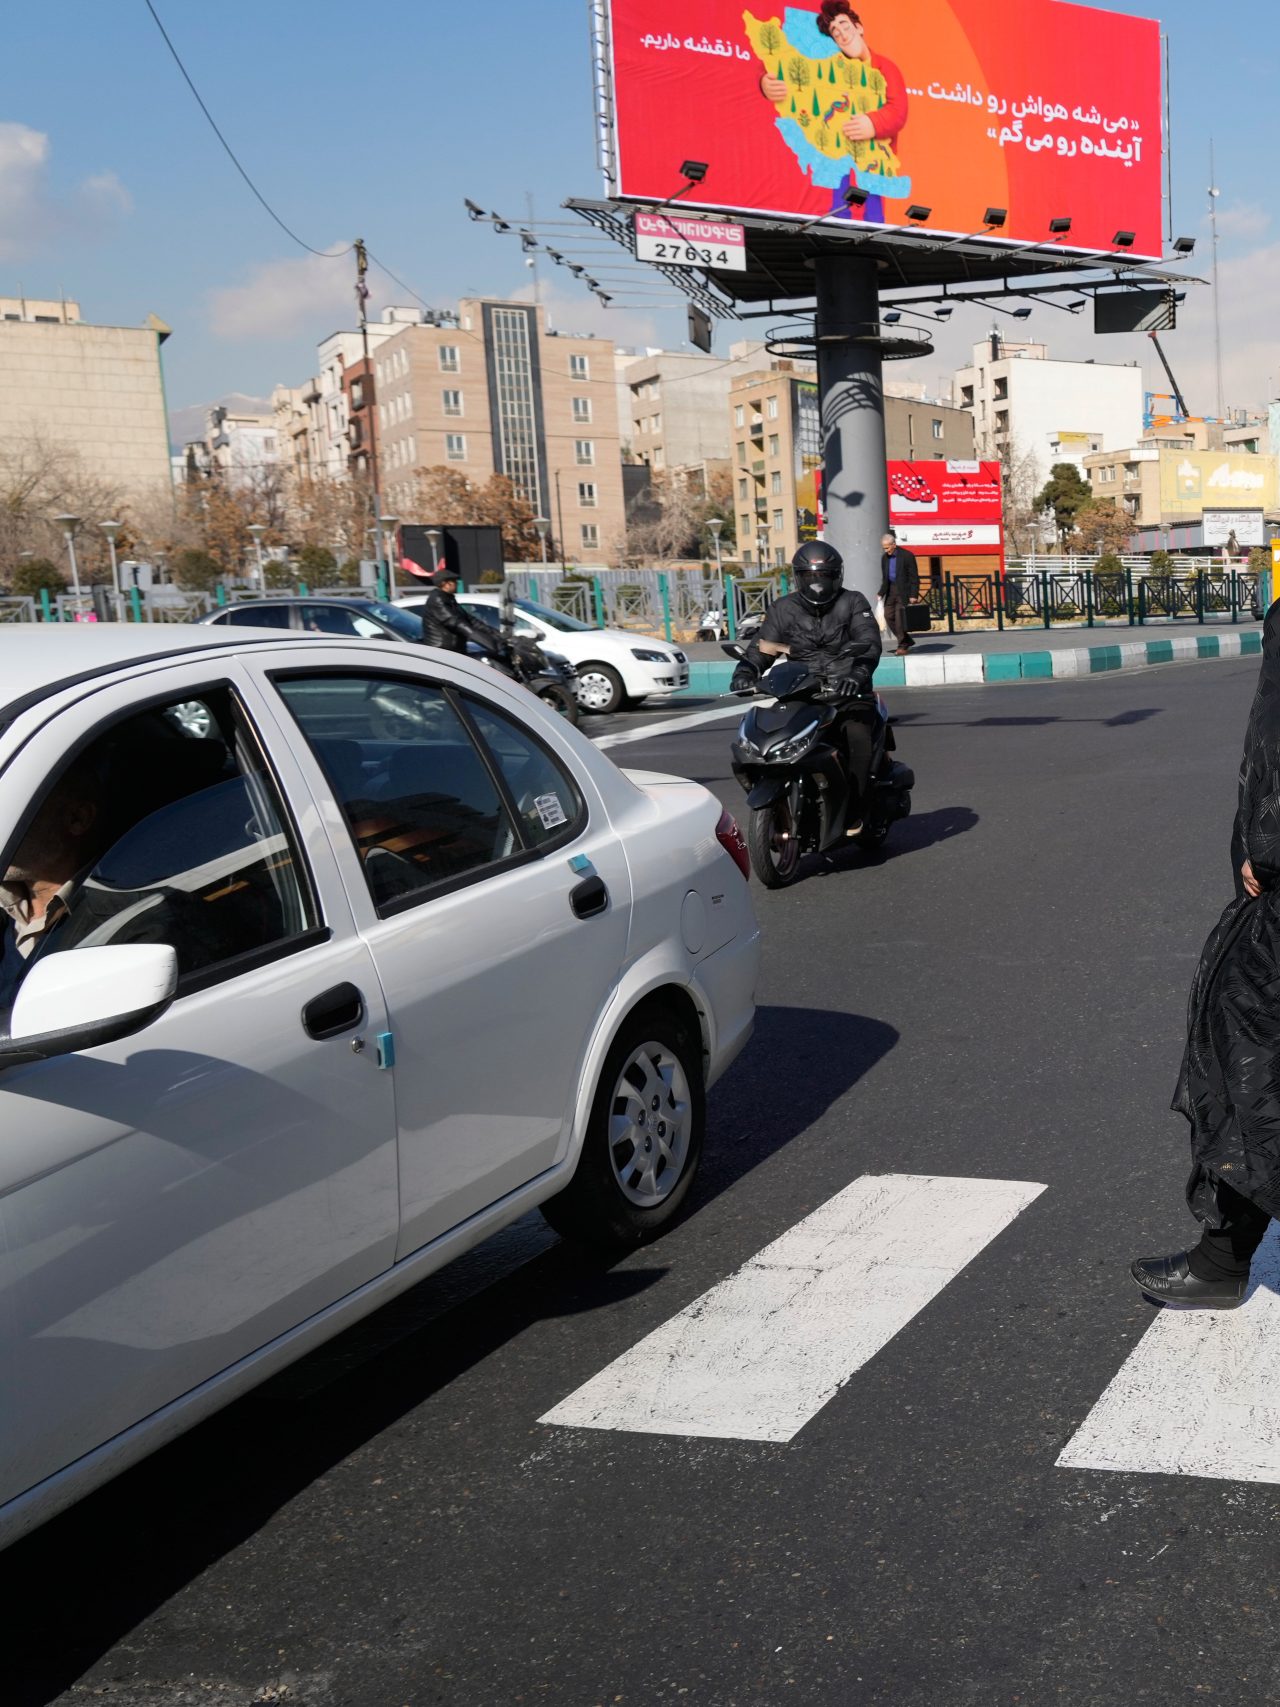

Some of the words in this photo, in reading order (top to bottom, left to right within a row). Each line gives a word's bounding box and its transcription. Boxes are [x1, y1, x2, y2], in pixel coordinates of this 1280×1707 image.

[640, 33, 680, 50] داریم.
[683, 36, 733, 57] نقشه
[735, 44, 751, 61] ما
[927, 82, 983, 105] داشت
[987, 92, 1007, 114] رو
[1011, 95, 1069, 122] هواش
[1056, 139, 1077, 157] رو
[1081, 136, 1142, 167] آینده
[700, 223, 742, 242] کانون
[655, 243, 728, 265] 27634
